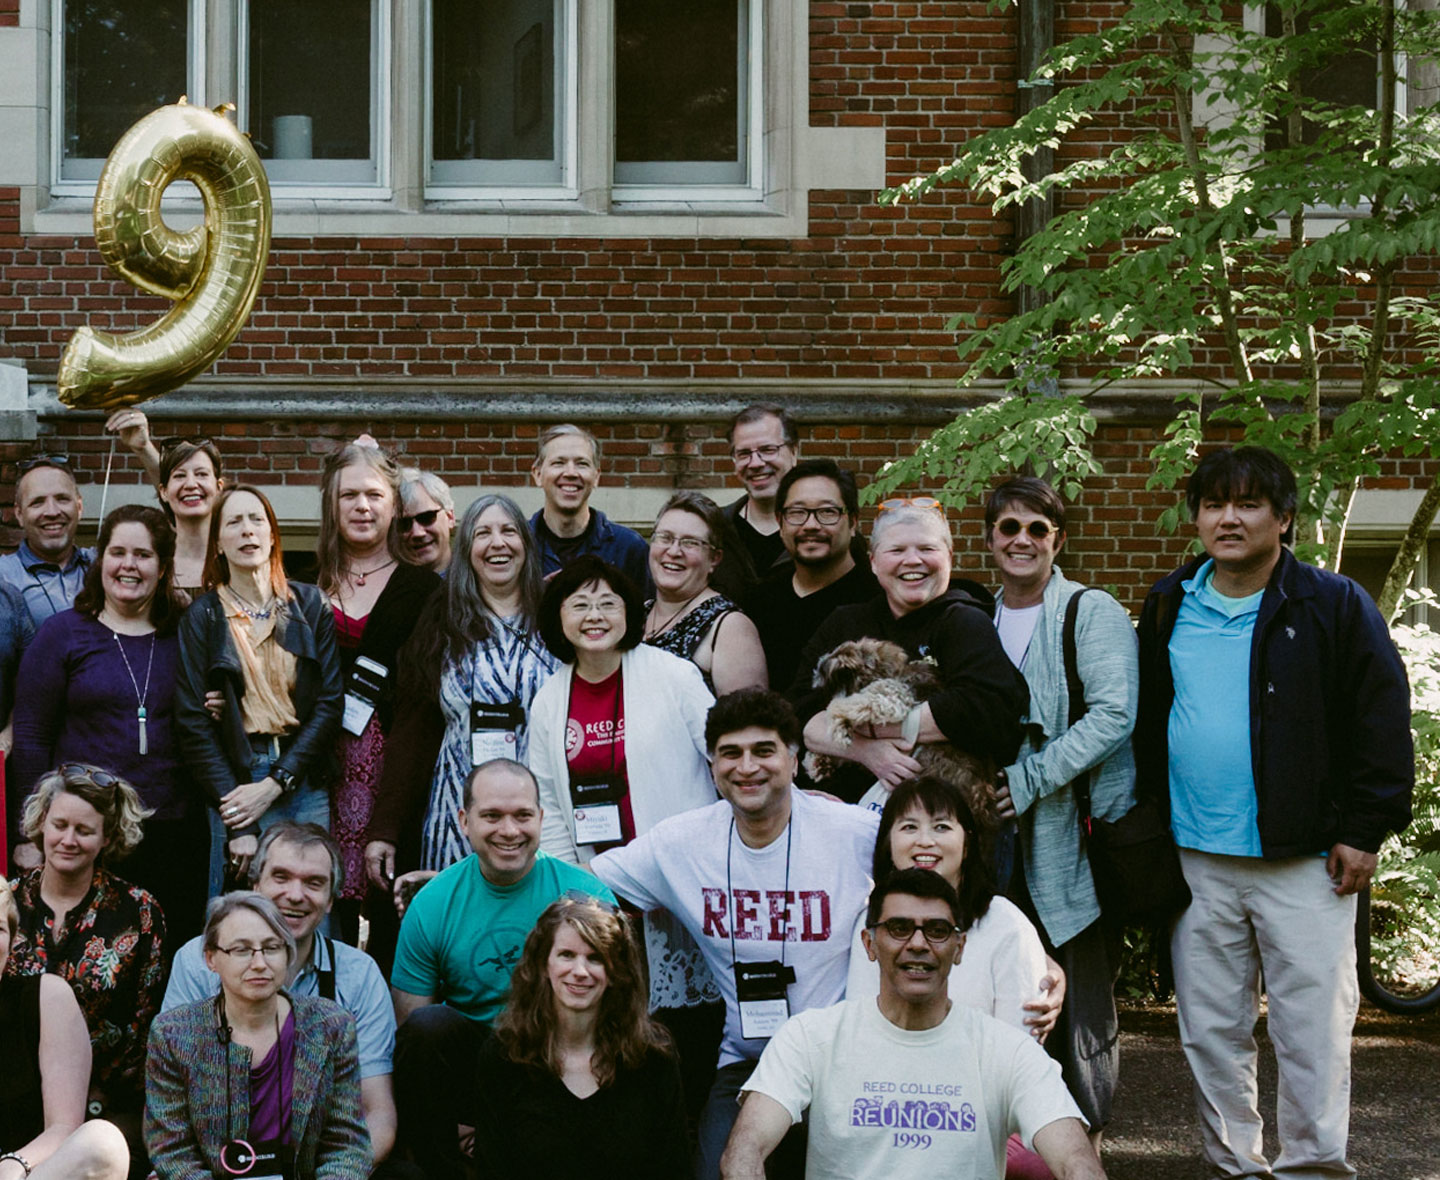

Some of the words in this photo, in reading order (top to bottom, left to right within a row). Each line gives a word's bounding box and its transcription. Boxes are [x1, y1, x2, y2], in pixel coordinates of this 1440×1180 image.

[57, 98, 271, 410] 9
[585, 720, 614, 734] REED
[701, 887, 832, 942] REED
[863, 1082, 897, 1093] REED
[900, 1083, 963, 1097] COLLEGE
[850, 1105, 976, 1132] REUNIONS
[893, 1133, 932, 1150] 1999
